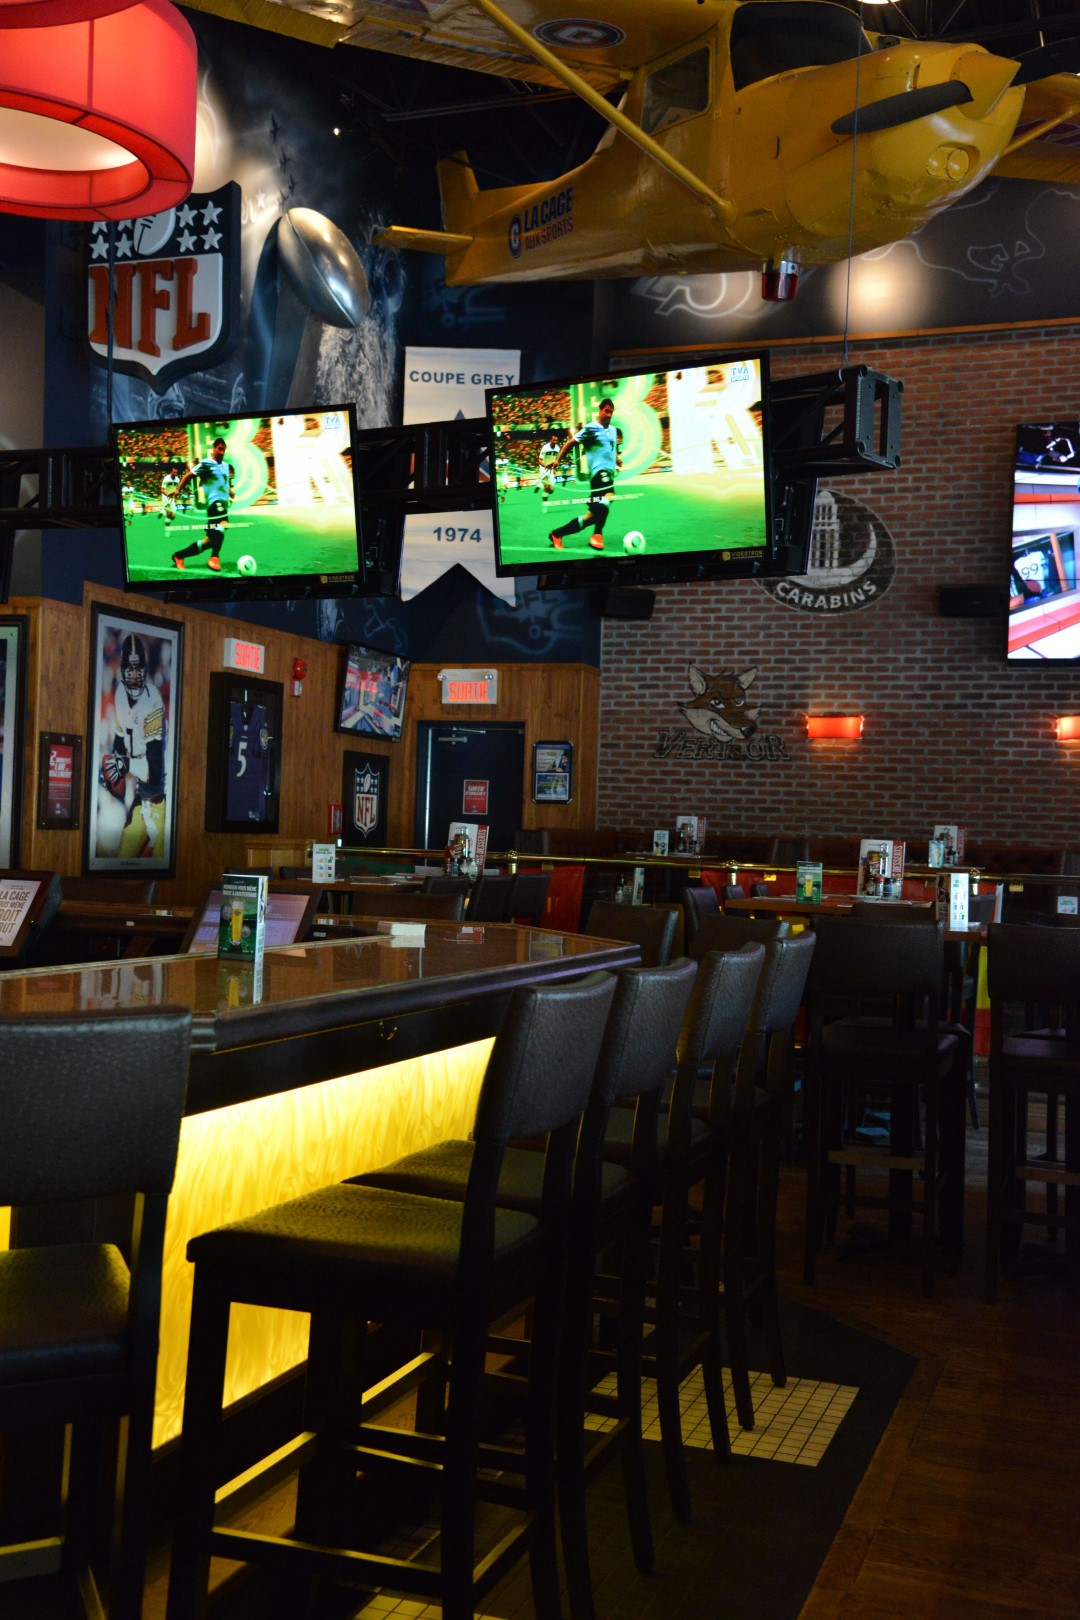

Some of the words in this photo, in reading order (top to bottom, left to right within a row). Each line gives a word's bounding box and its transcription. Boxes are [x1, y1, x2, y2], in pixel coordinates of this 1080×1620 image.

[524, 203, 540, 233] LA
[541, 185, 575, 226] CAGE
[541, 215, 574, 245] SPORTS
[89, 257, 211, 358] NFL
[409, 370, 466, 385] COUPE
[471, 373, 516, 386] GREY
[731, 367, 749, 377] TVA
[433, 526, 482, 543] 1974
[1021, 563, 1039, 579] 99
[776, 580, 877, 609] CARABINS
[234, 642, 263, 671] SORTIE
[448, 681, 490, 703] SORTIE
[49, 751, 58, 766] 2
[236, 741, 248, 777] 5
[356, 796, 376, 828] NFL
[892, 845, 903, 873] DESSERTS
[9, 890, 31, 901] CAGE
